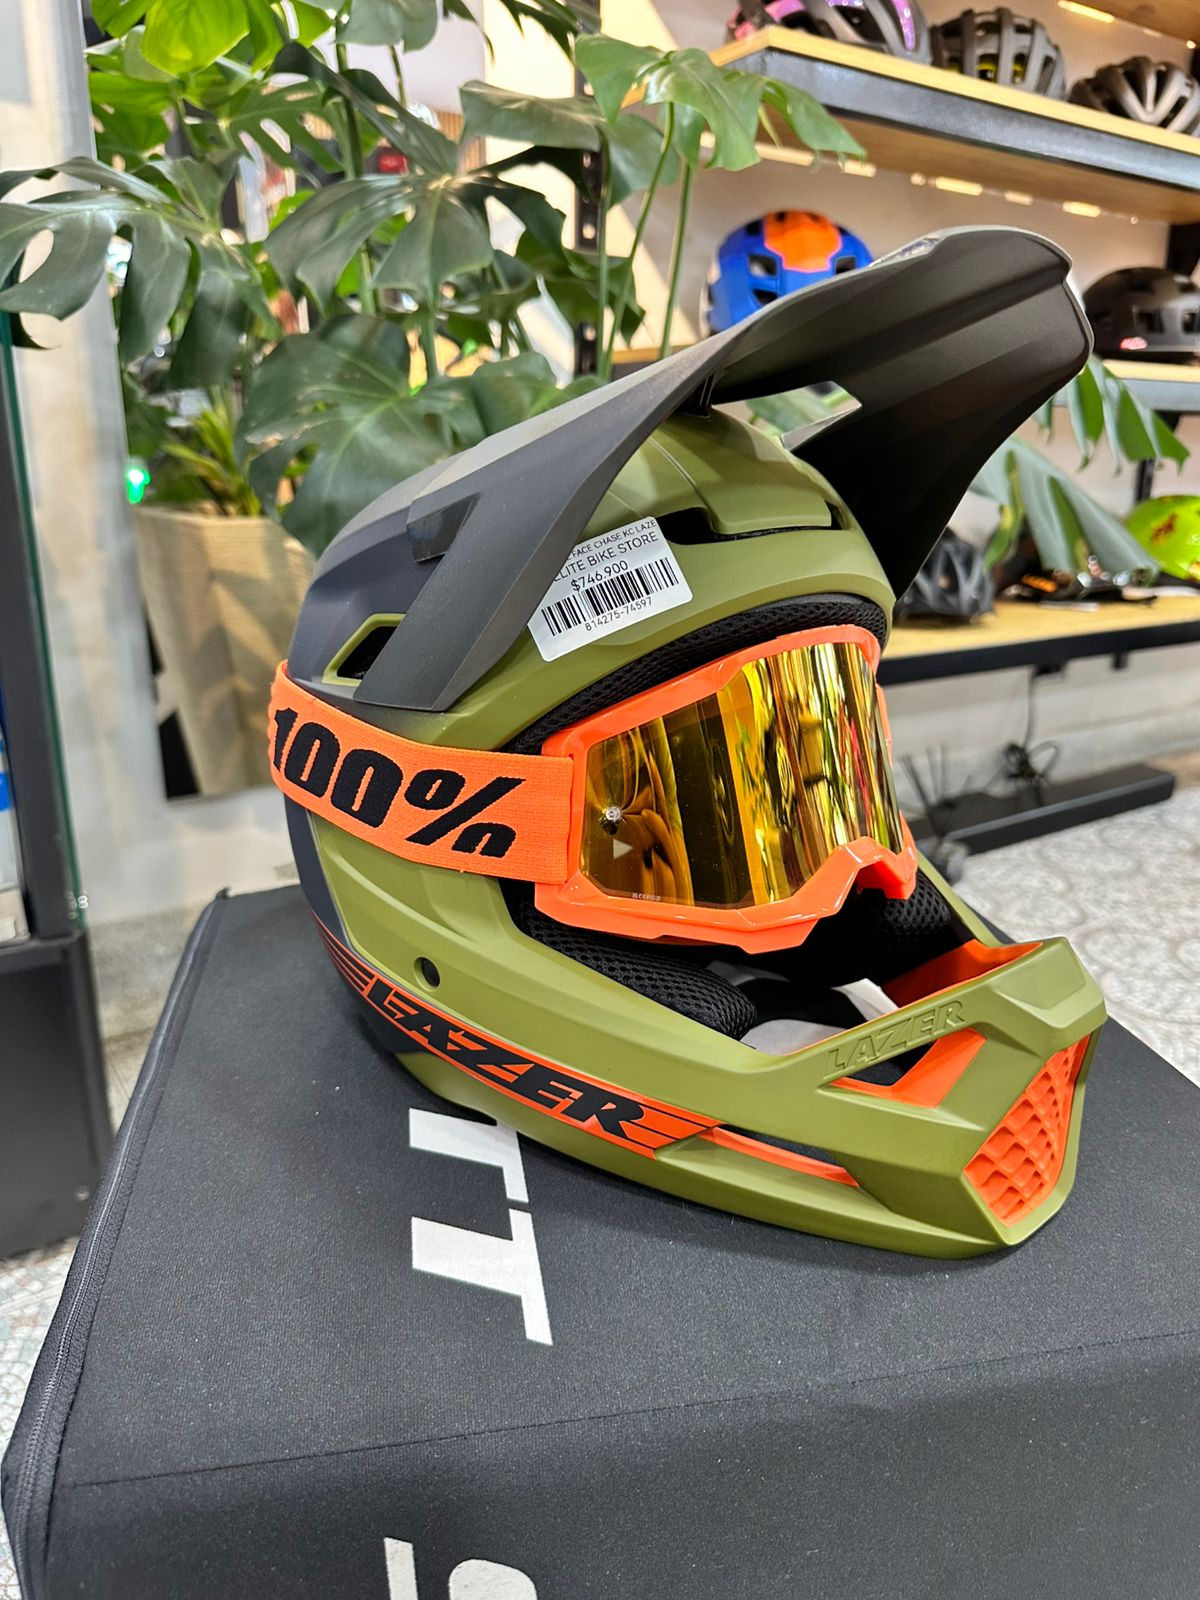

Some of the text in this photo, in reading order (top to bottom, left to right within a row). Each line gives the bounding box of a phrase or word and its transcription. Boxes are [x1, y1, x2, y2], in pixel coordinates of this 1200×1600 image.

[554, 531, 659, 582] LITE BIKE STORE
[571, 520, 656, 558] FACE CHASE KC LAZE
[571, 560, 628, 592] $746.900
[585, 597, 653, 632] 814275-74597
[273, 707, 527, 859] 100%
[366, 978, 645, 1139] LAZER
[823, 1000, 966, 1080] LAZER
